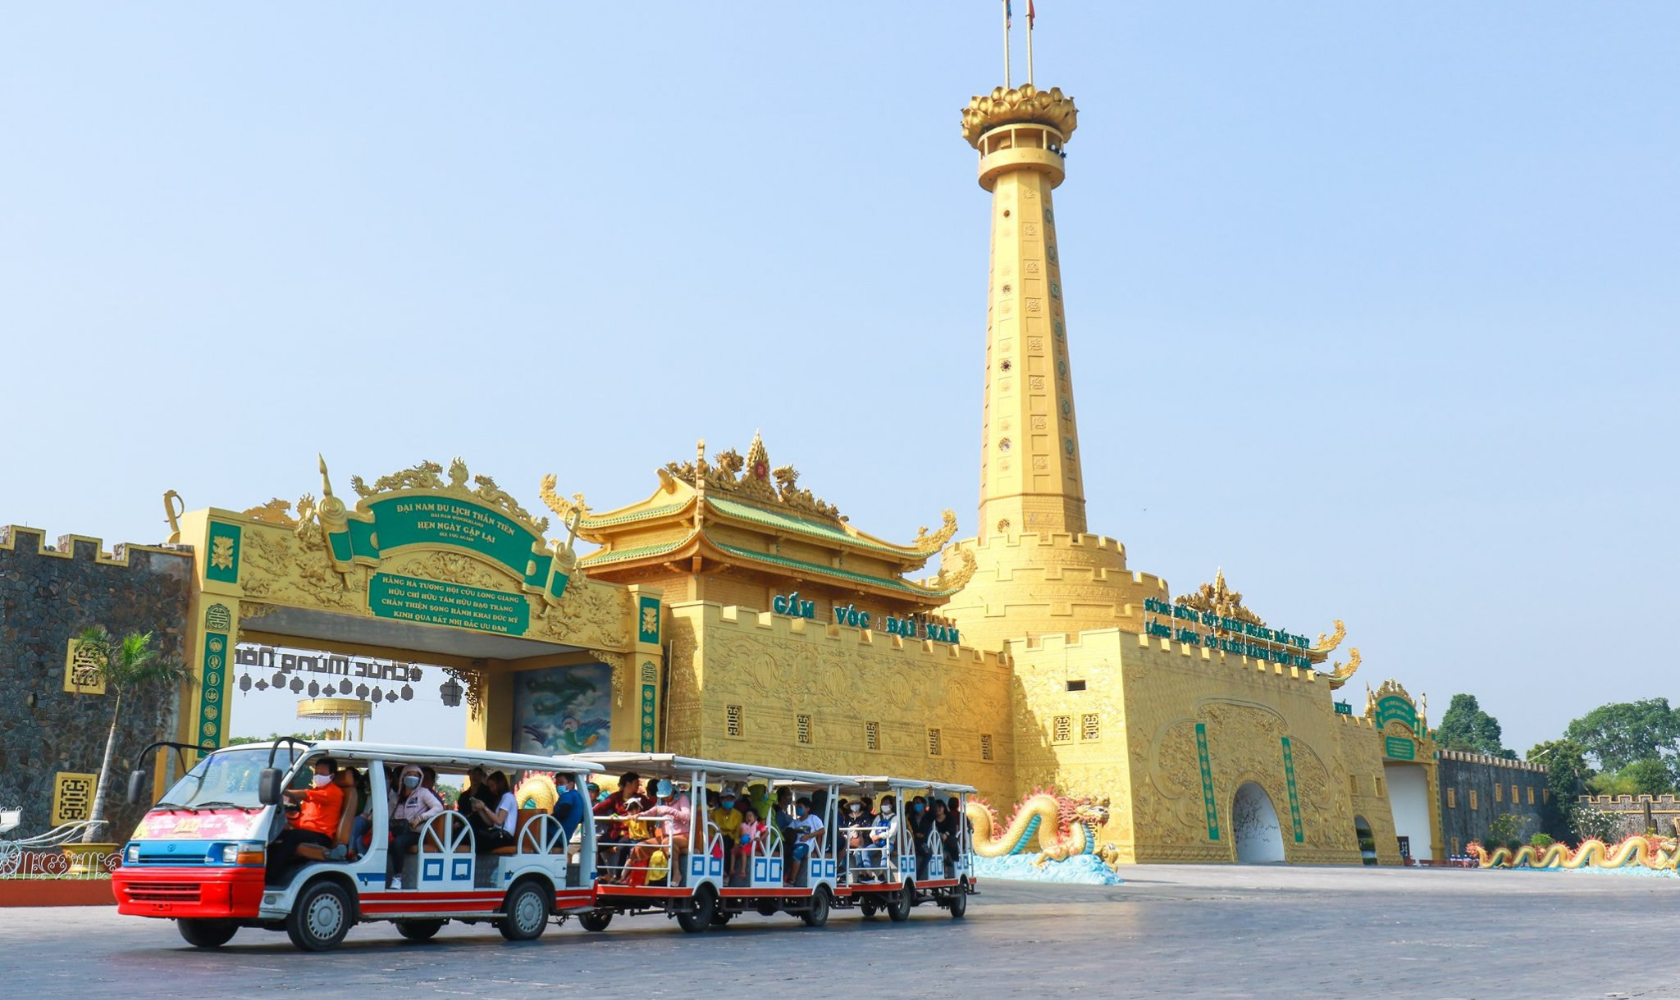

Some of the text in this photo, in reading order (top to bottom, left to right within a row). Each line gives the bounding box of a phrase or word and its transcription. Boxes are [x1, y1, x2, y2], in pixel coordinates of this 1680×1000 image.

[415, 503, 435, 511] NAM
[437, 504, 449, 512] DU
[451, 505, 470, 516] LỊCH
[417, 521, 435, 531] HẸN
[481, 532, 496, 543] LẠI
[477, 591, 496, 600] LONG
[497, 594, 519, 603] GIANG
[393, 610, 414, 619] KINH
[415, 613, 431, 622] QUA
[429, 605, 449, 613] SONG
[473, 611, 491, 620] KHAI
[773, 591, 960, 645] GẤM VÓC ĐẠI NAM
